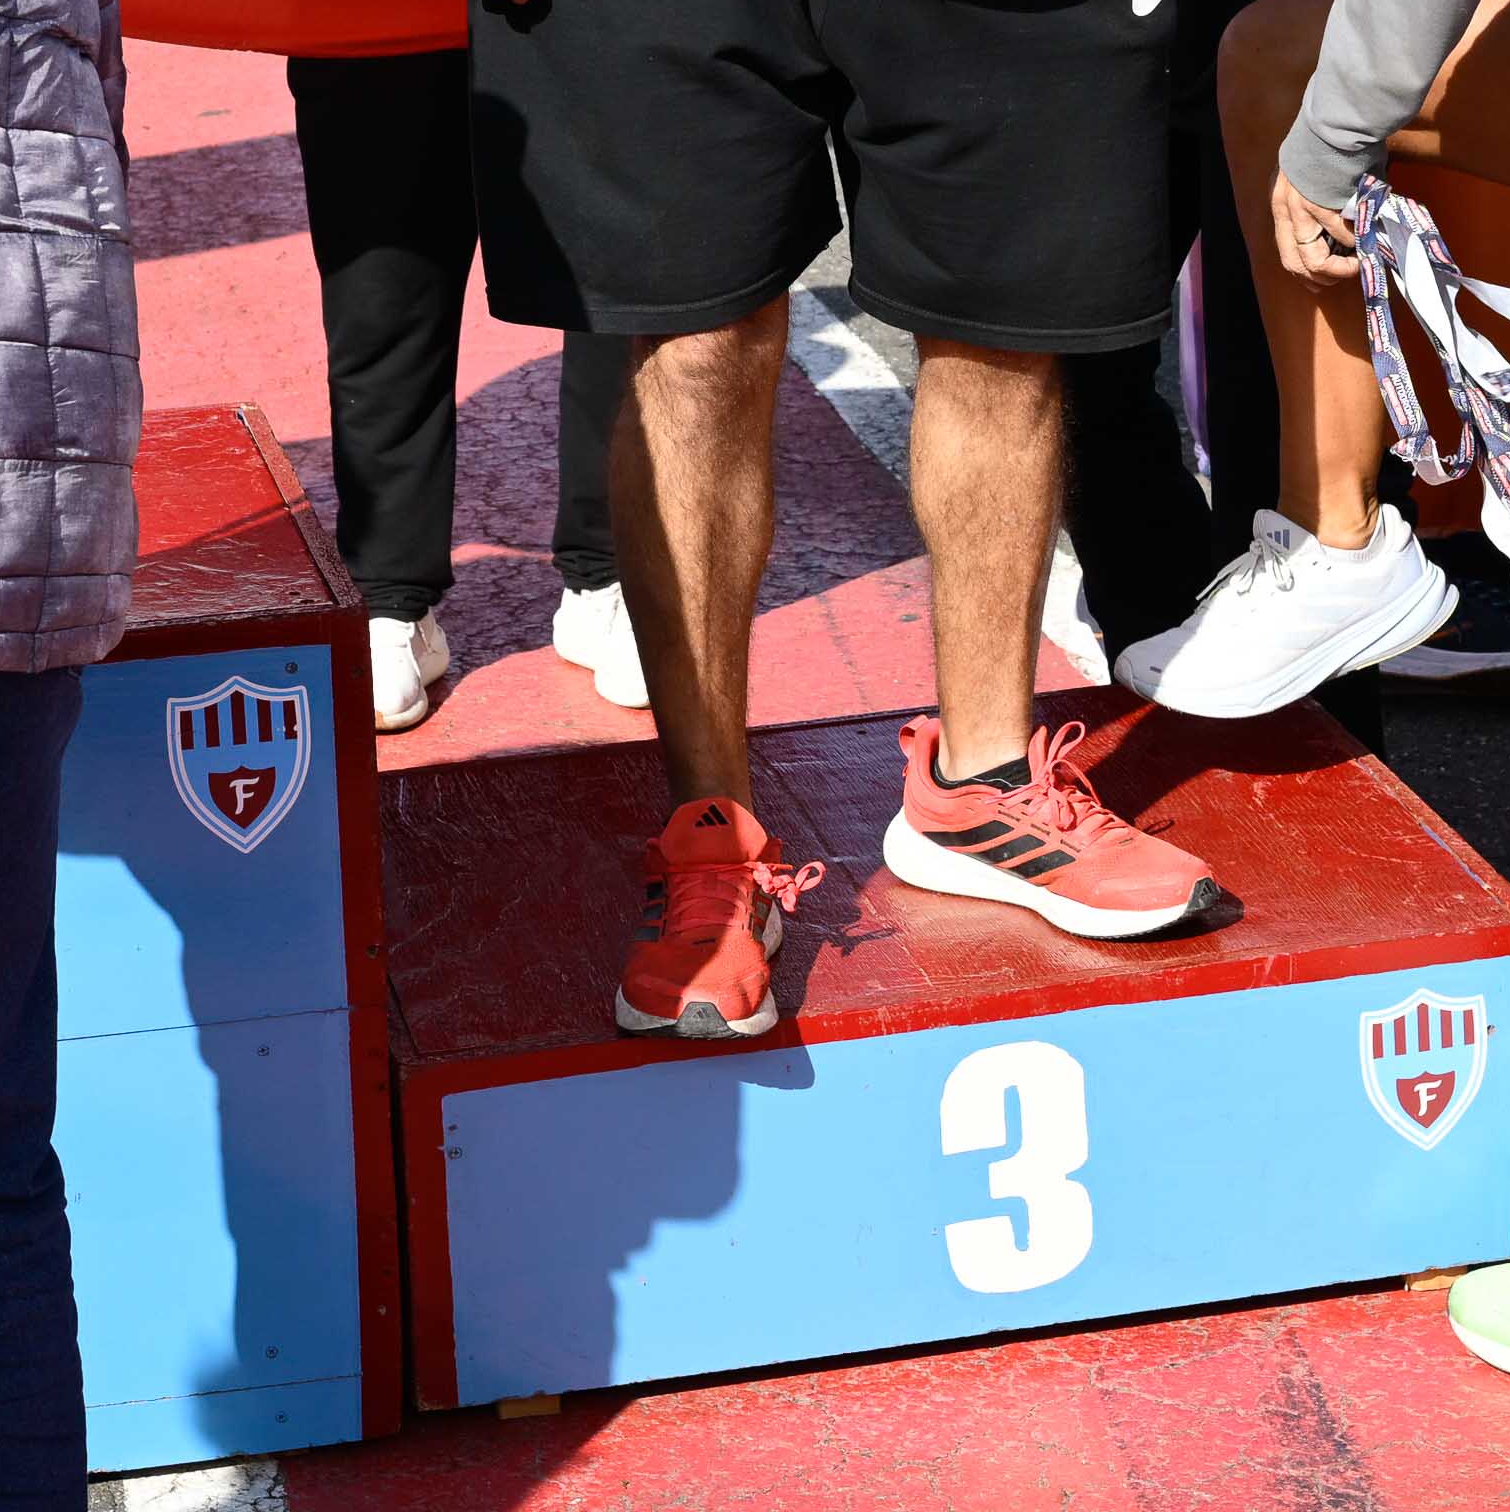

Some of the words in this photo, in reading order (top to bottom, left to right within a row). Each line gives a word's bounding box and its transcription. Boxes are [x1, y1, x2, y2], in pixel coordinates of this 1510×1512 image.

[1390, 373, 1417, 426] AUTODROMO
[228, 776, 261, 816] F
[1413, 1078, 1443, 1118] F
[939, 1040, 1094, 1294] 3
